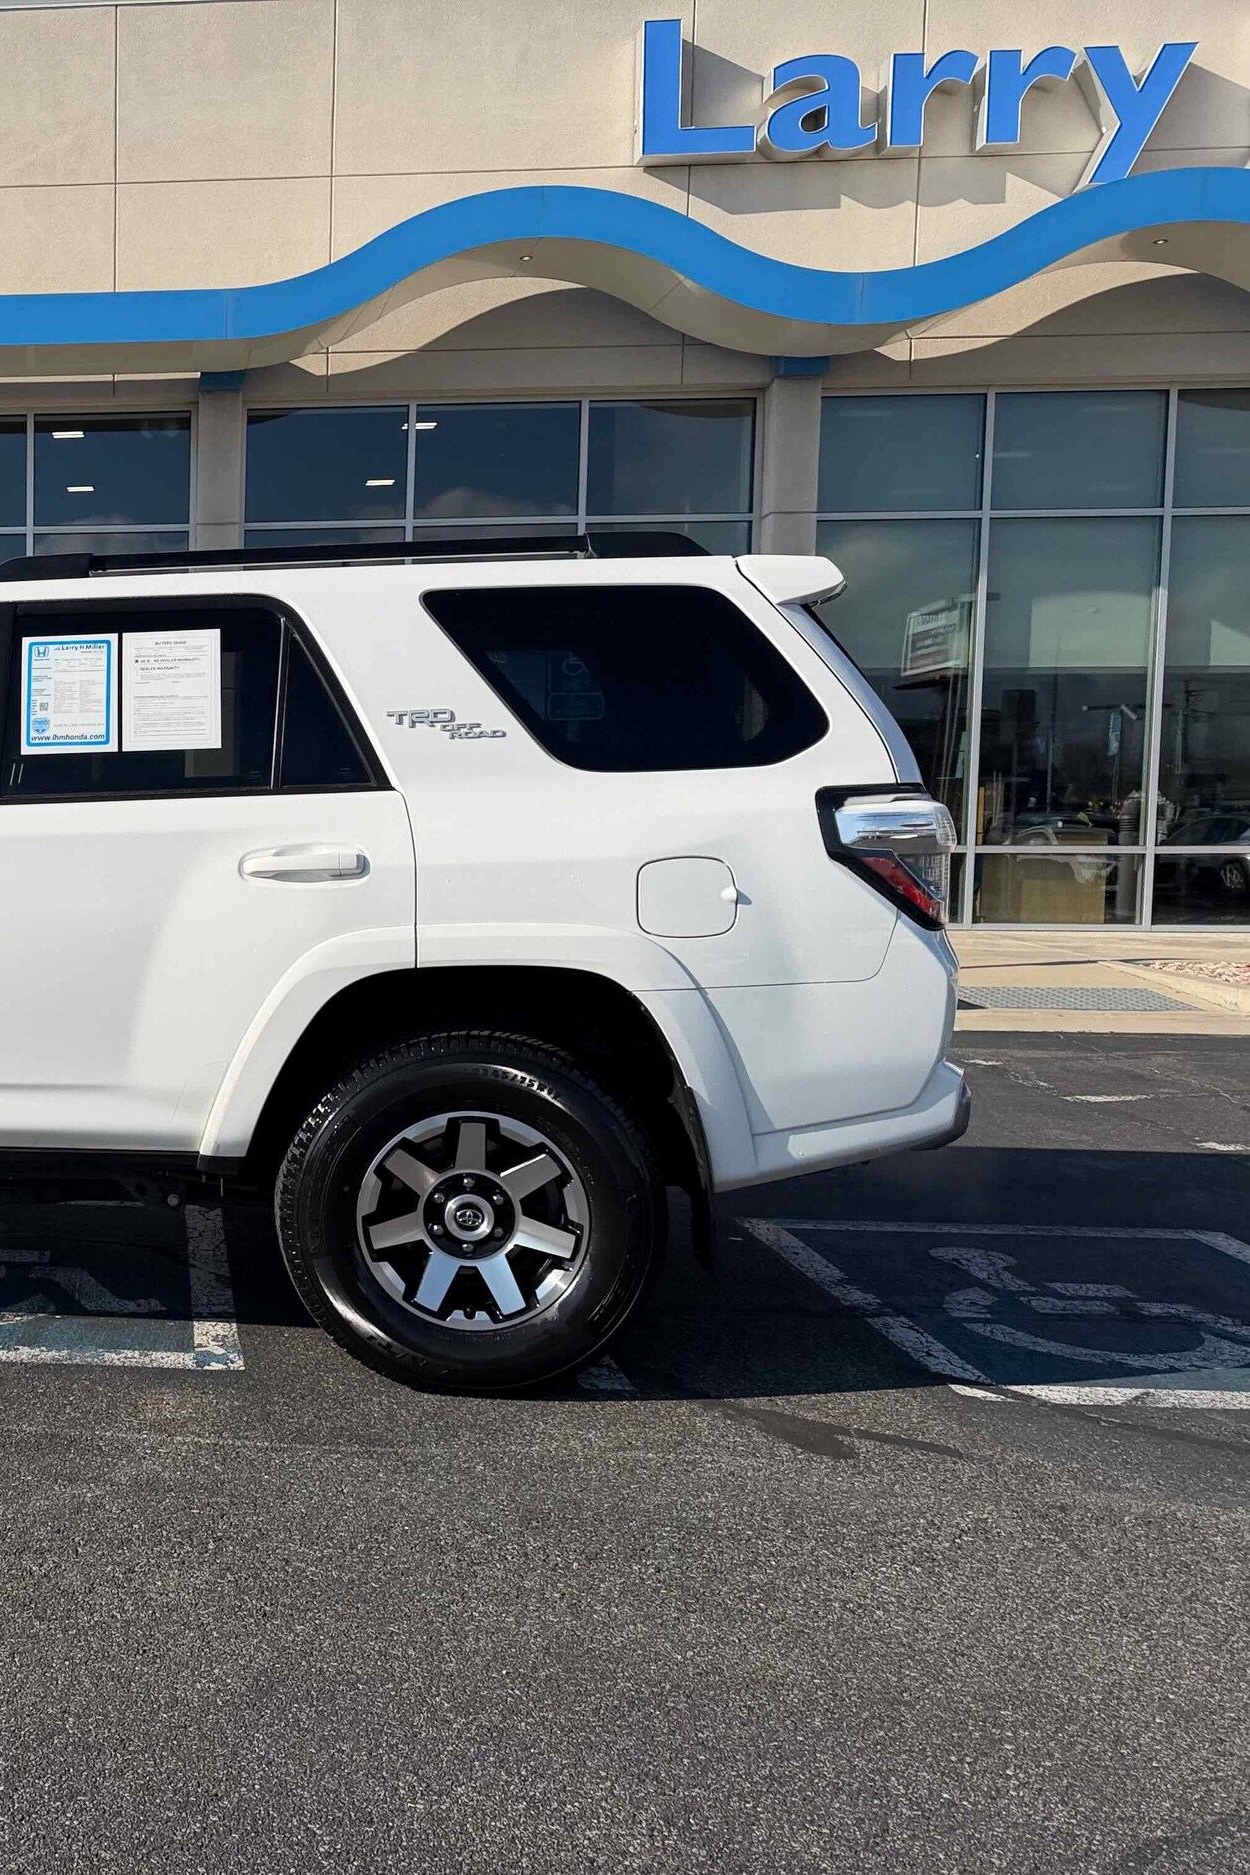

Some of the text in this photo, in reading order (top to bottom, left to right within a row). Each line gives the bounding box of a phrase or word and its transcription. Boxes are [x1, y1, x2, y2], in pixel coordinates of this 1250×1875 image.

[637, 18, 1201, 187] Larry
[387, 708, 456, 728] TRD
[31, 733, 105, 741] www.lhmhonda.com
[440, 723, 507, 740] OFF ROAD
